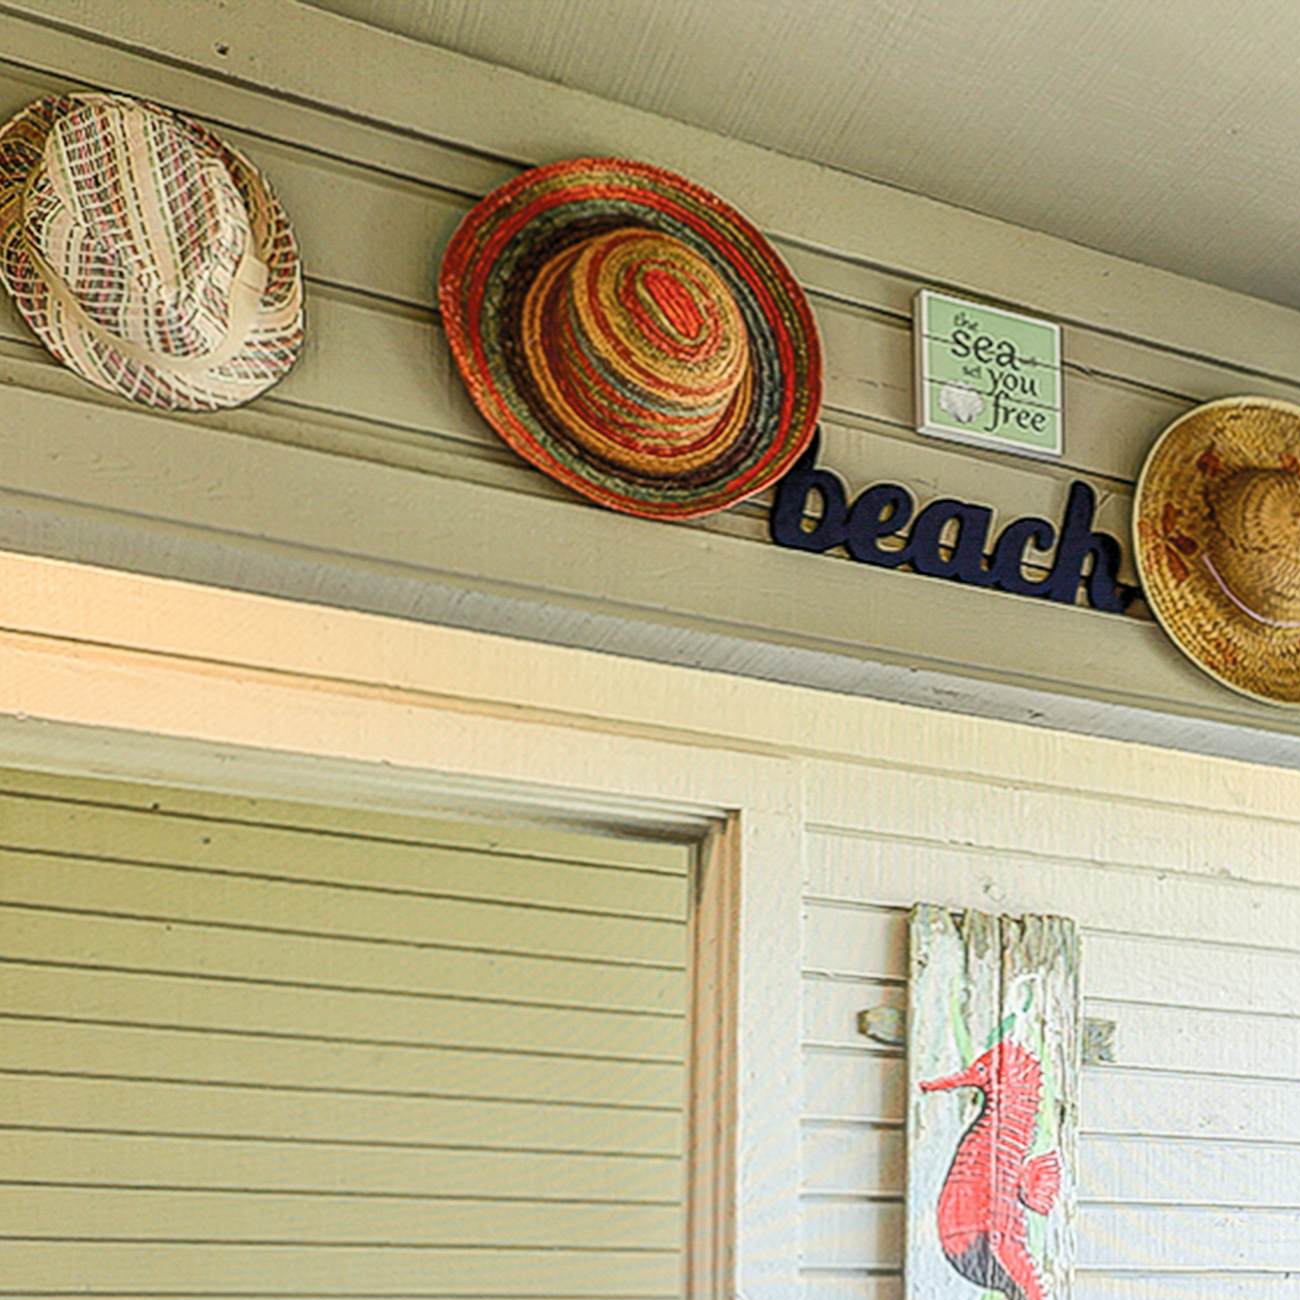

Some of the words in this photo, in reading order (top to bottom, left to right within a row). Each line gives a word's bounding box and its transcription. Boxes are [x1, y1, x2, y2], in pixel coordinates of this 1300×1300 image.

[951, 329, 1020, 371] sea
[985, 368, 1038, 397] you
[983, 390, 1046, 433] free
[770, 423, 1141, 615] beach
